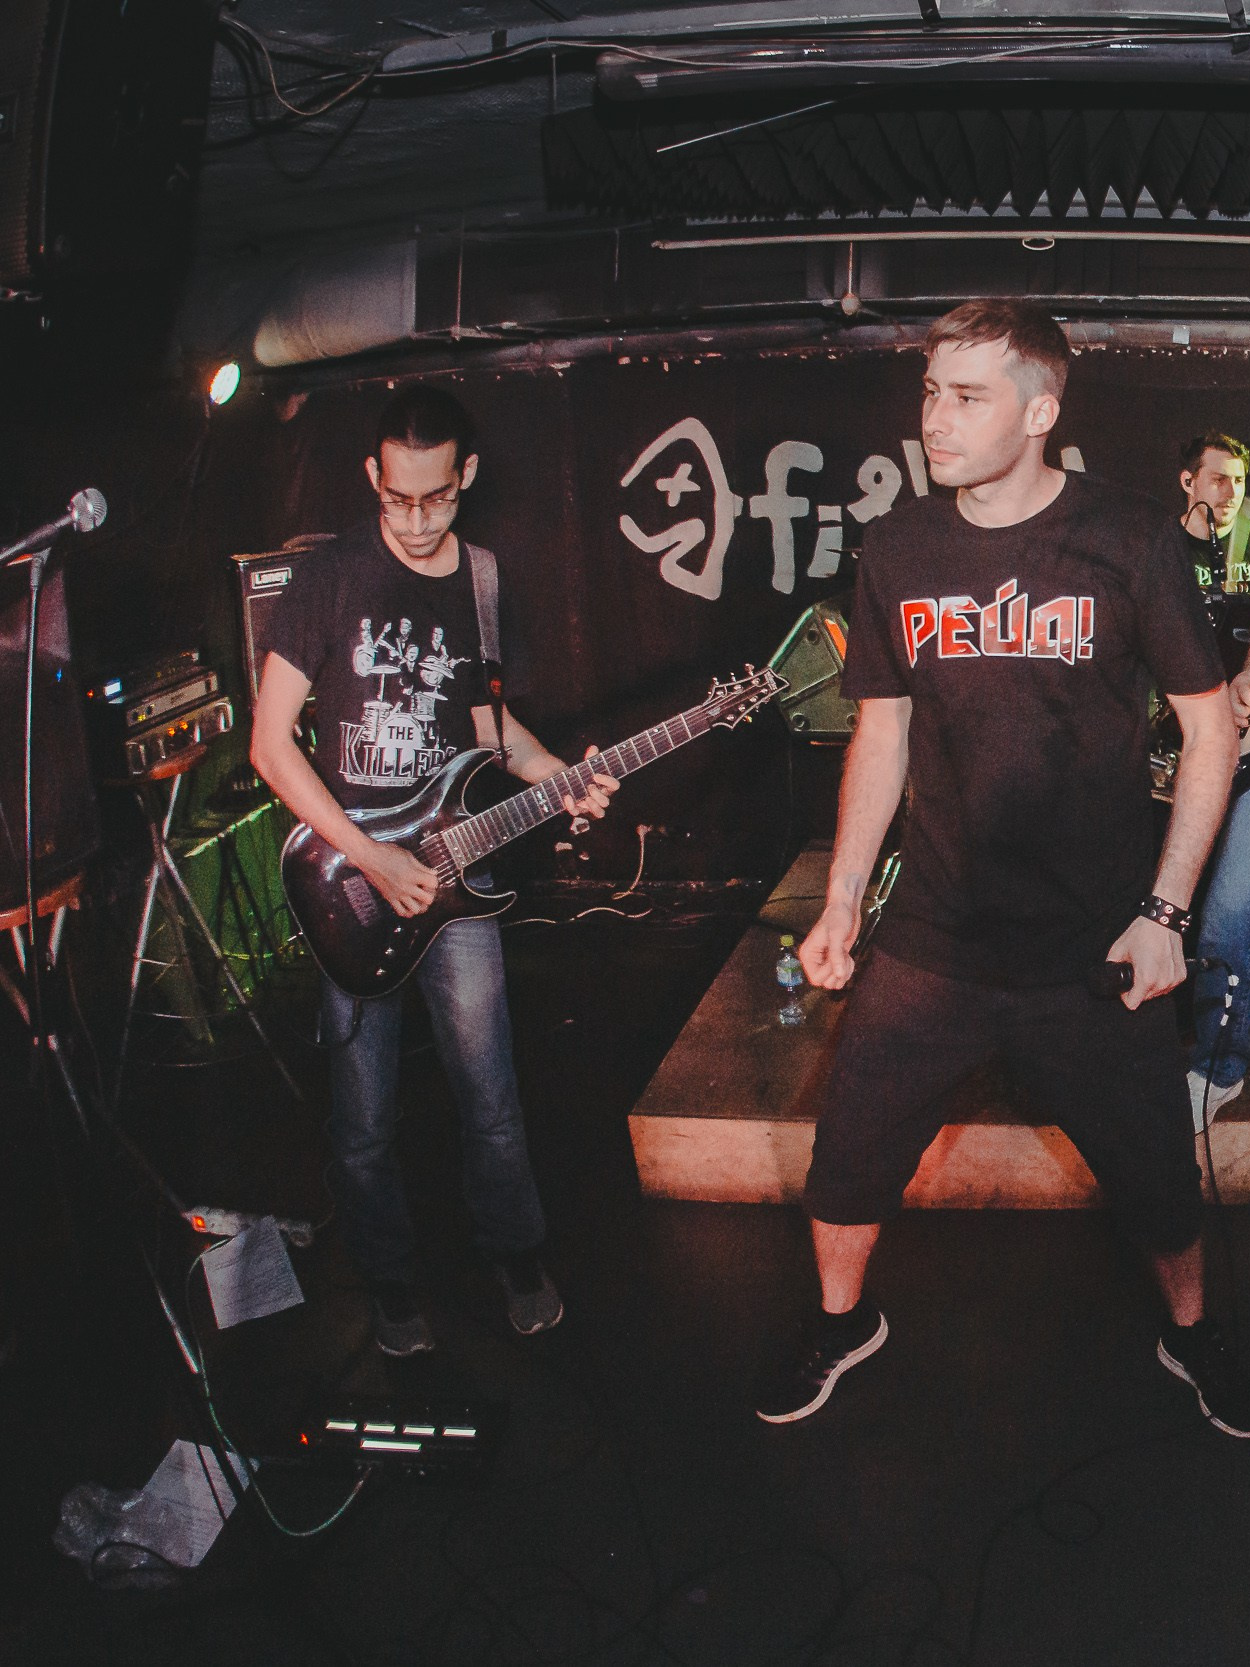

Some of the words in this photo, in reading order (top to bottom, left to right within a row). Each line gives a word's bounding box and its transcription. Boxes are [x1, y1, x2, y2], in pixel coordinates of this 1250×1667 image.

[254, 570, 289, 586] Laney
[387, 725, 414, 741] THE
[338, 721, 458, 779] KILLER
